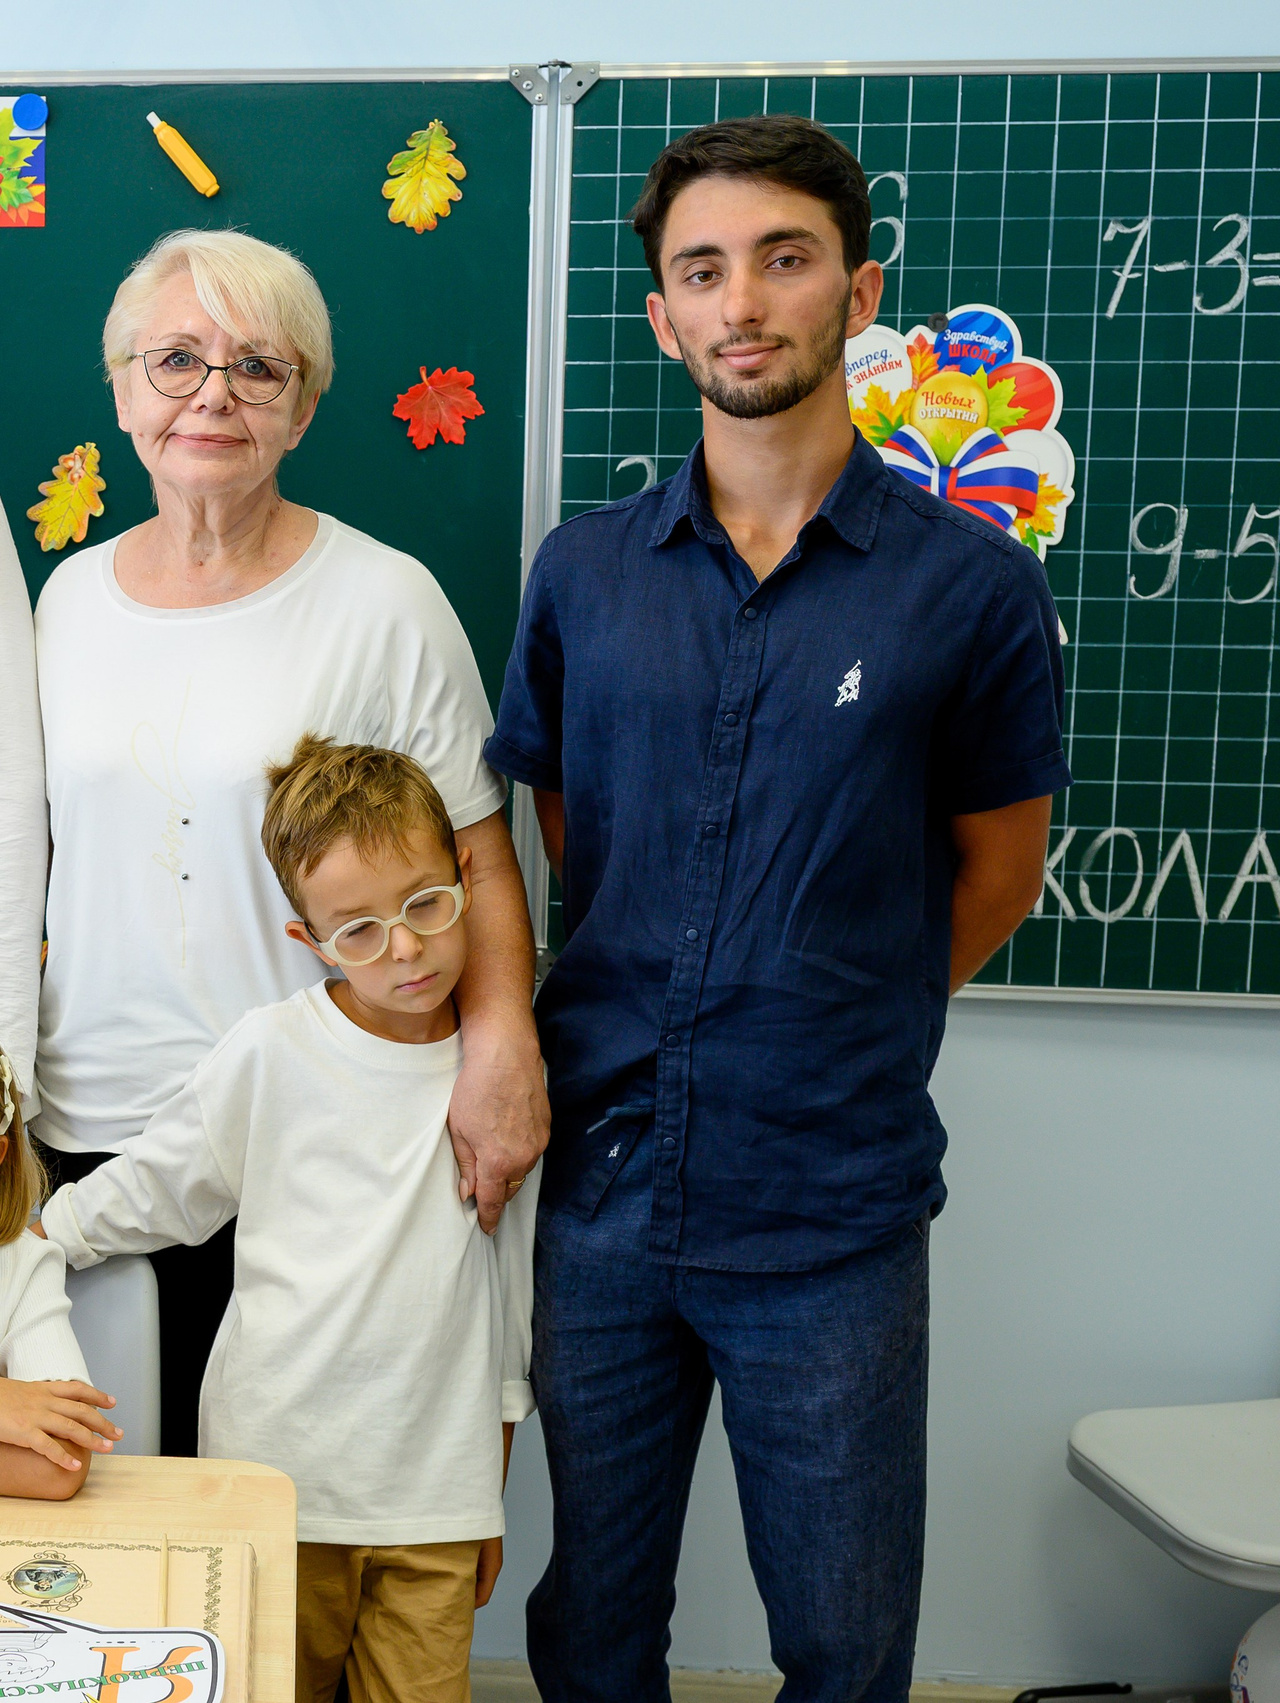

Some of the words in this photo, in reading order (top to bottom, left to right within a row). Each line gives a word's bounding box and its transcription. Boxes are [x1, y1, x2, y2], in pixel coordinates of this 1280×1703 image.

[943, 328, 1008, 353] Здравствуй,
[948, 342, 998, 366] ШКОЛА
[921, 391, 976, 409] Новых
[1033, 826, 1280, 926] КОЛА
